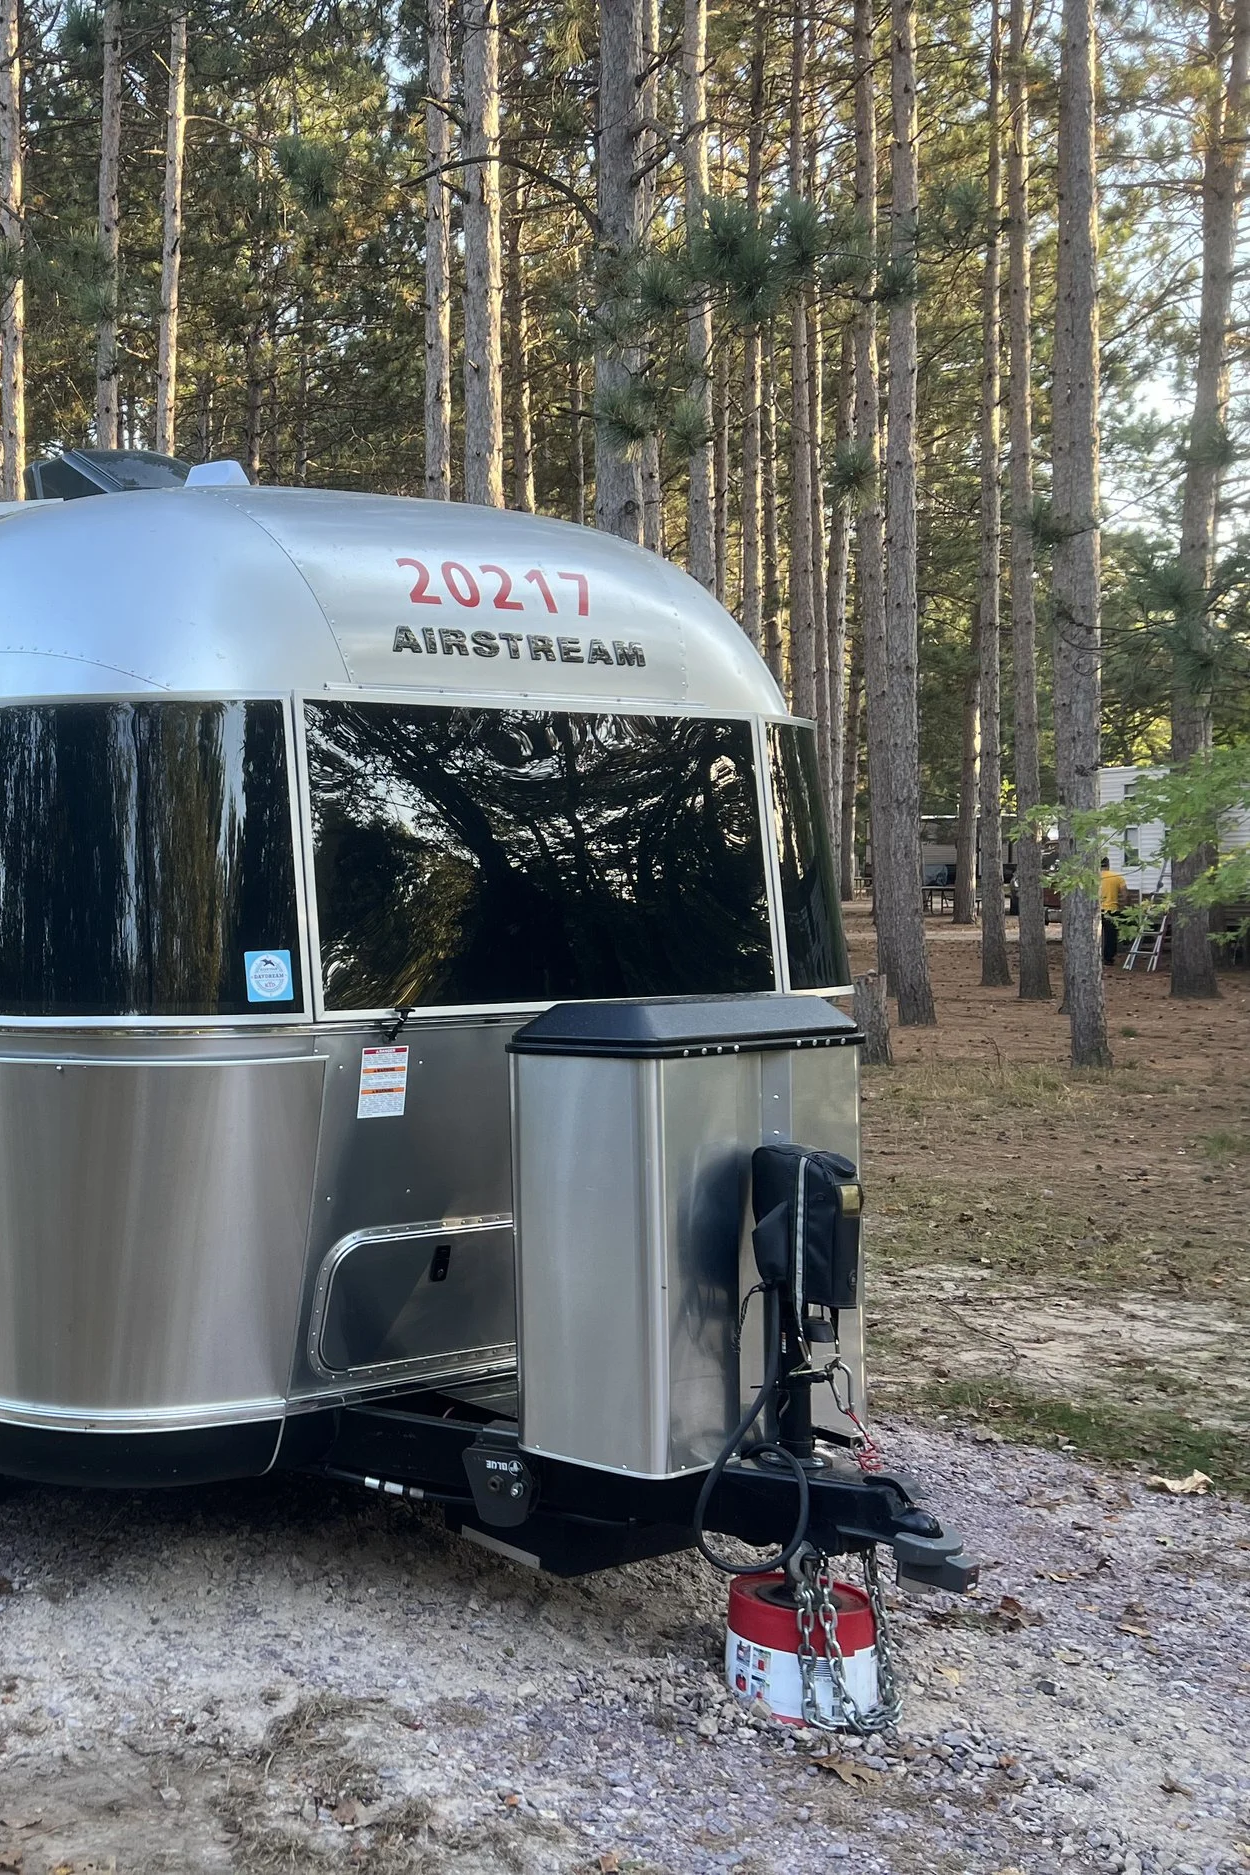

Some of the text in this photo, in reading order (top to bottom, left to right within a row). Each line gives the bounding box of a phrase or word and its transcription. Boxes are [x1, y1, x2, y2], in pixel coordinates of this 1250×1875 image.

[395, 557, 589, 616] 20217
[392, 625, 647, 667] AIRSTREAM
[485, 1460, 508, 1471] BLUE
